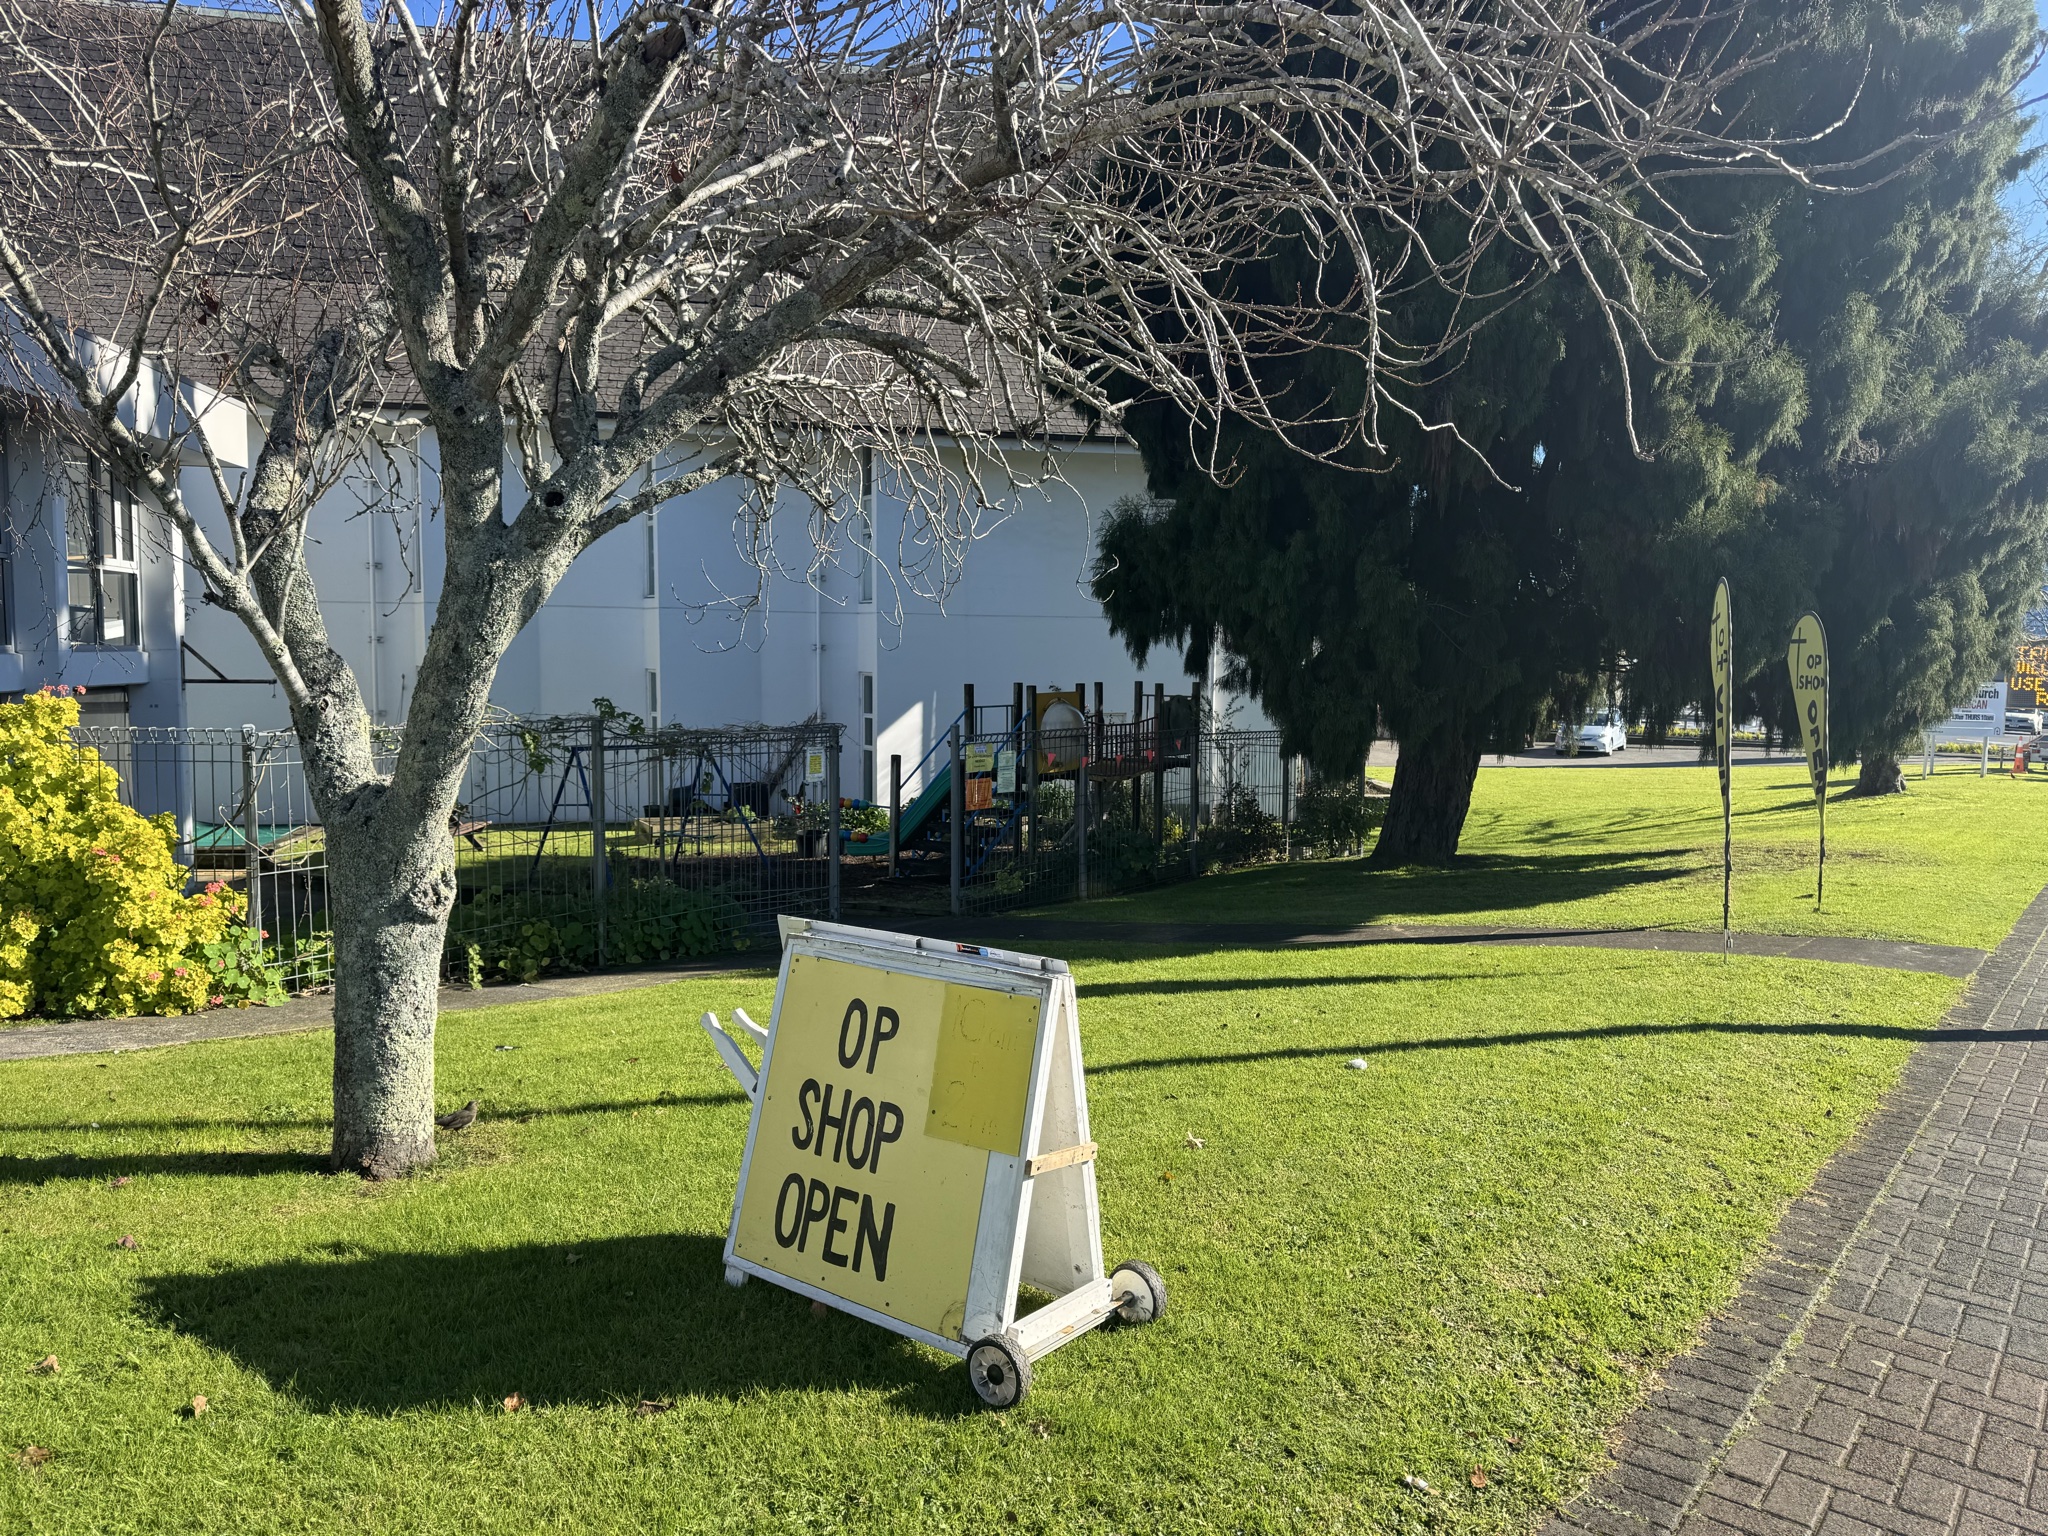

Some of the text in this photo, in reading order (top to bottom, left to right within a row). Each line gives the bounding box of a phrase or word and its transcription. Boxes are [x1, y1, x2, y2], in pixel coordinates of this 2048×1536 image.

[1806, 654, 1822, 670] OP
[2010, 677, 2046, 692] USE
[1808, 699, 1826, 796] OPEN
[838, 998, 900, 1074] OP
[792, 1078, 904, 1174] SHOP
[774, 1172, 896, 1282] OPEN
